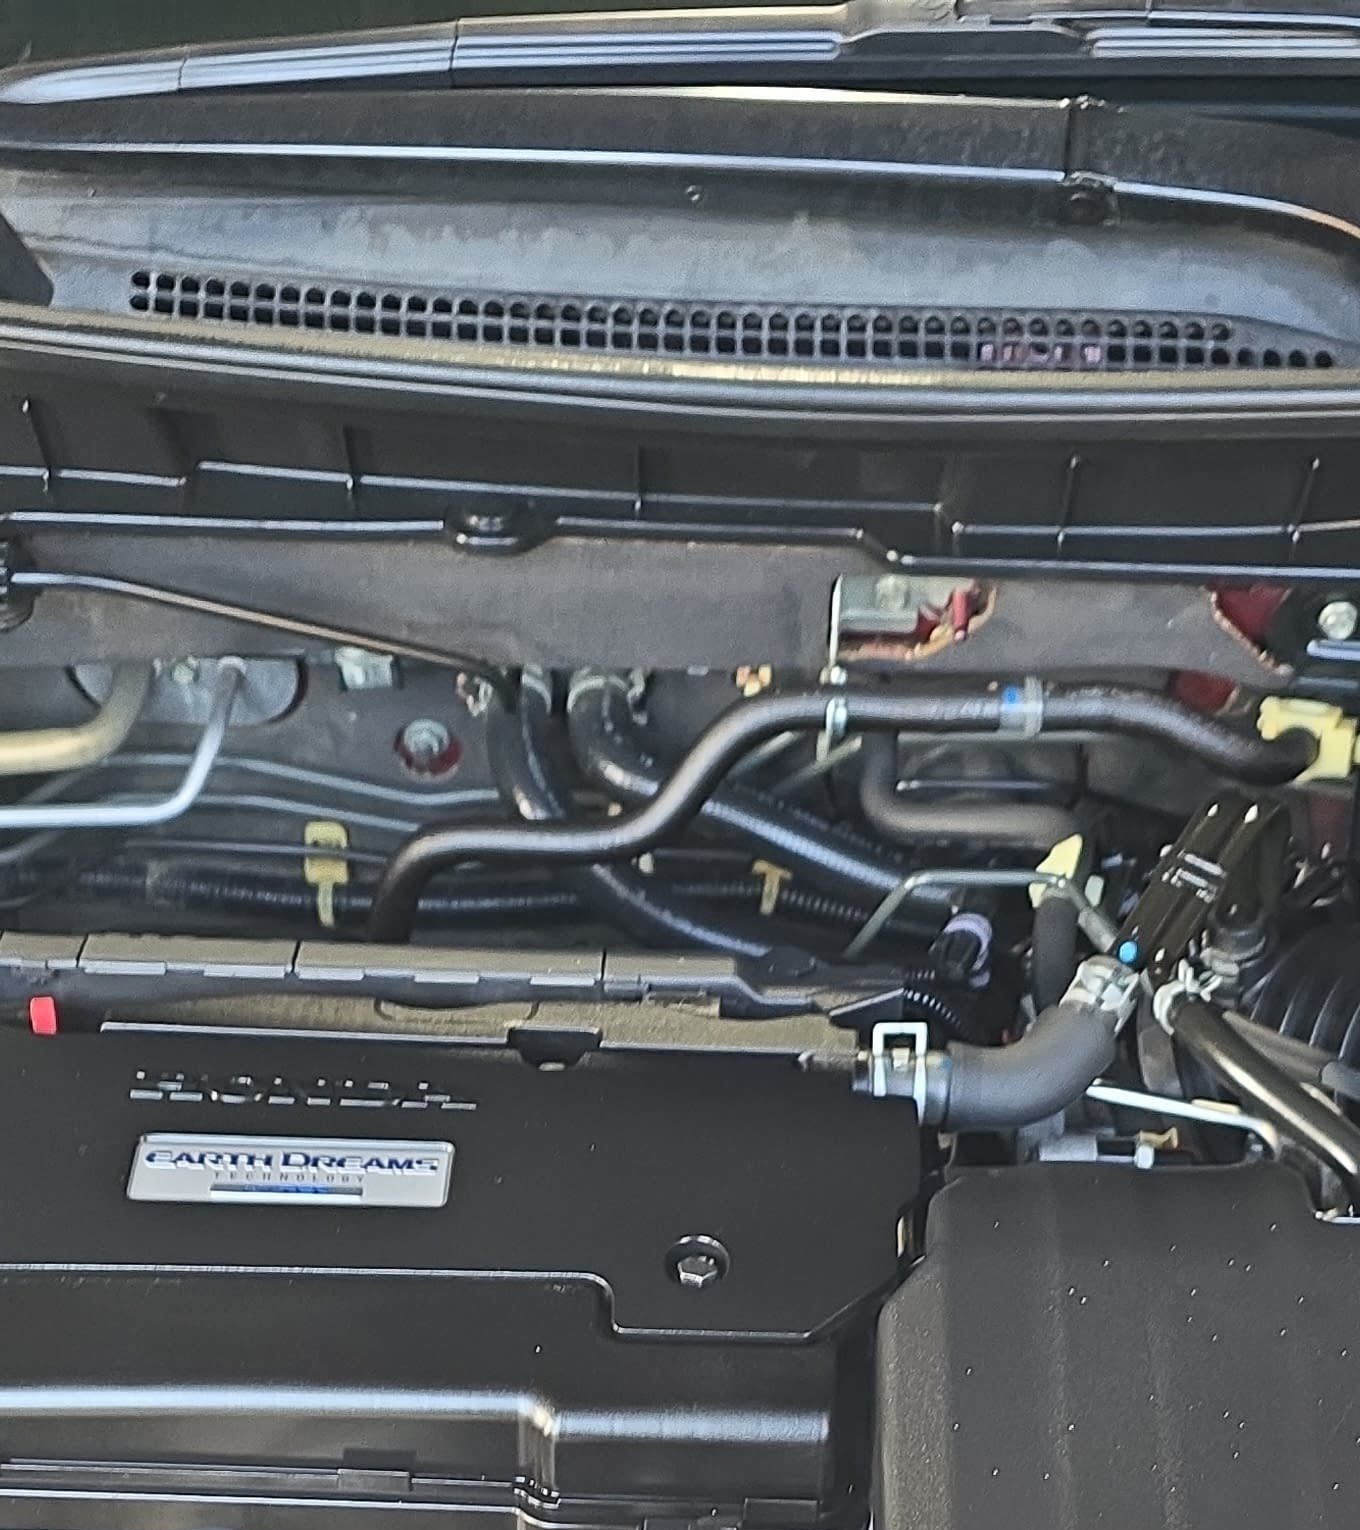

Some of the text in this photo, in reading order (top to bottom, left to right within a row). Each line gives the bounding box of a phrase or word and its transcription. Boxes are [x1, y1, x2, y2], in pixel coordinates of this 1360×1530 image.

[145, 1151, 439, 1174] EARTH DREAMS
[213, 1172, 366, 1184] TECHNOLOGY
